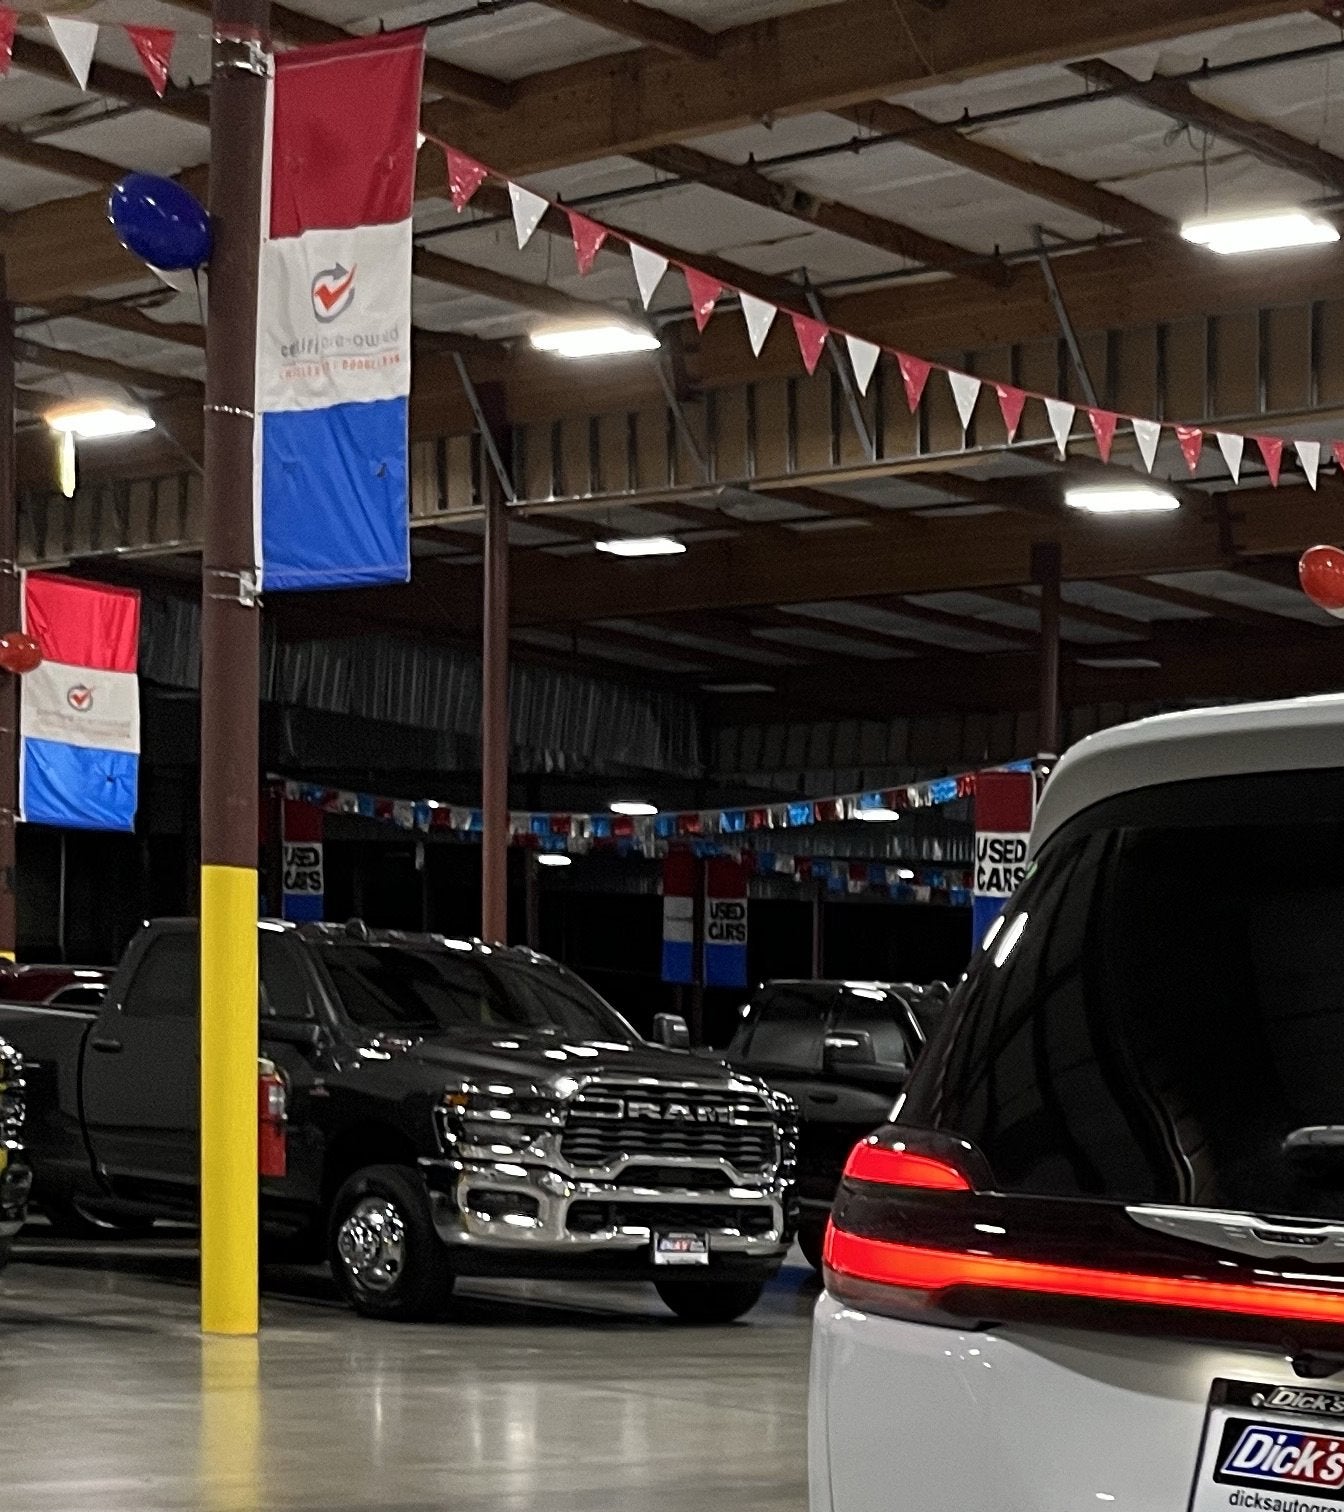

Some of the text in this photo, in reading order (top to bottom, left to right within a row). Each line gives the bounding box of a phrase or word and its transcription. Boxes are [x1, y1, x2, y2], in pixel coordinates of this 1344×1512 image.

[977, 837, 1027, 863] USED
[977, 865, 1026, 892] CARS
[627, 1102, 731, 1122] RAM
